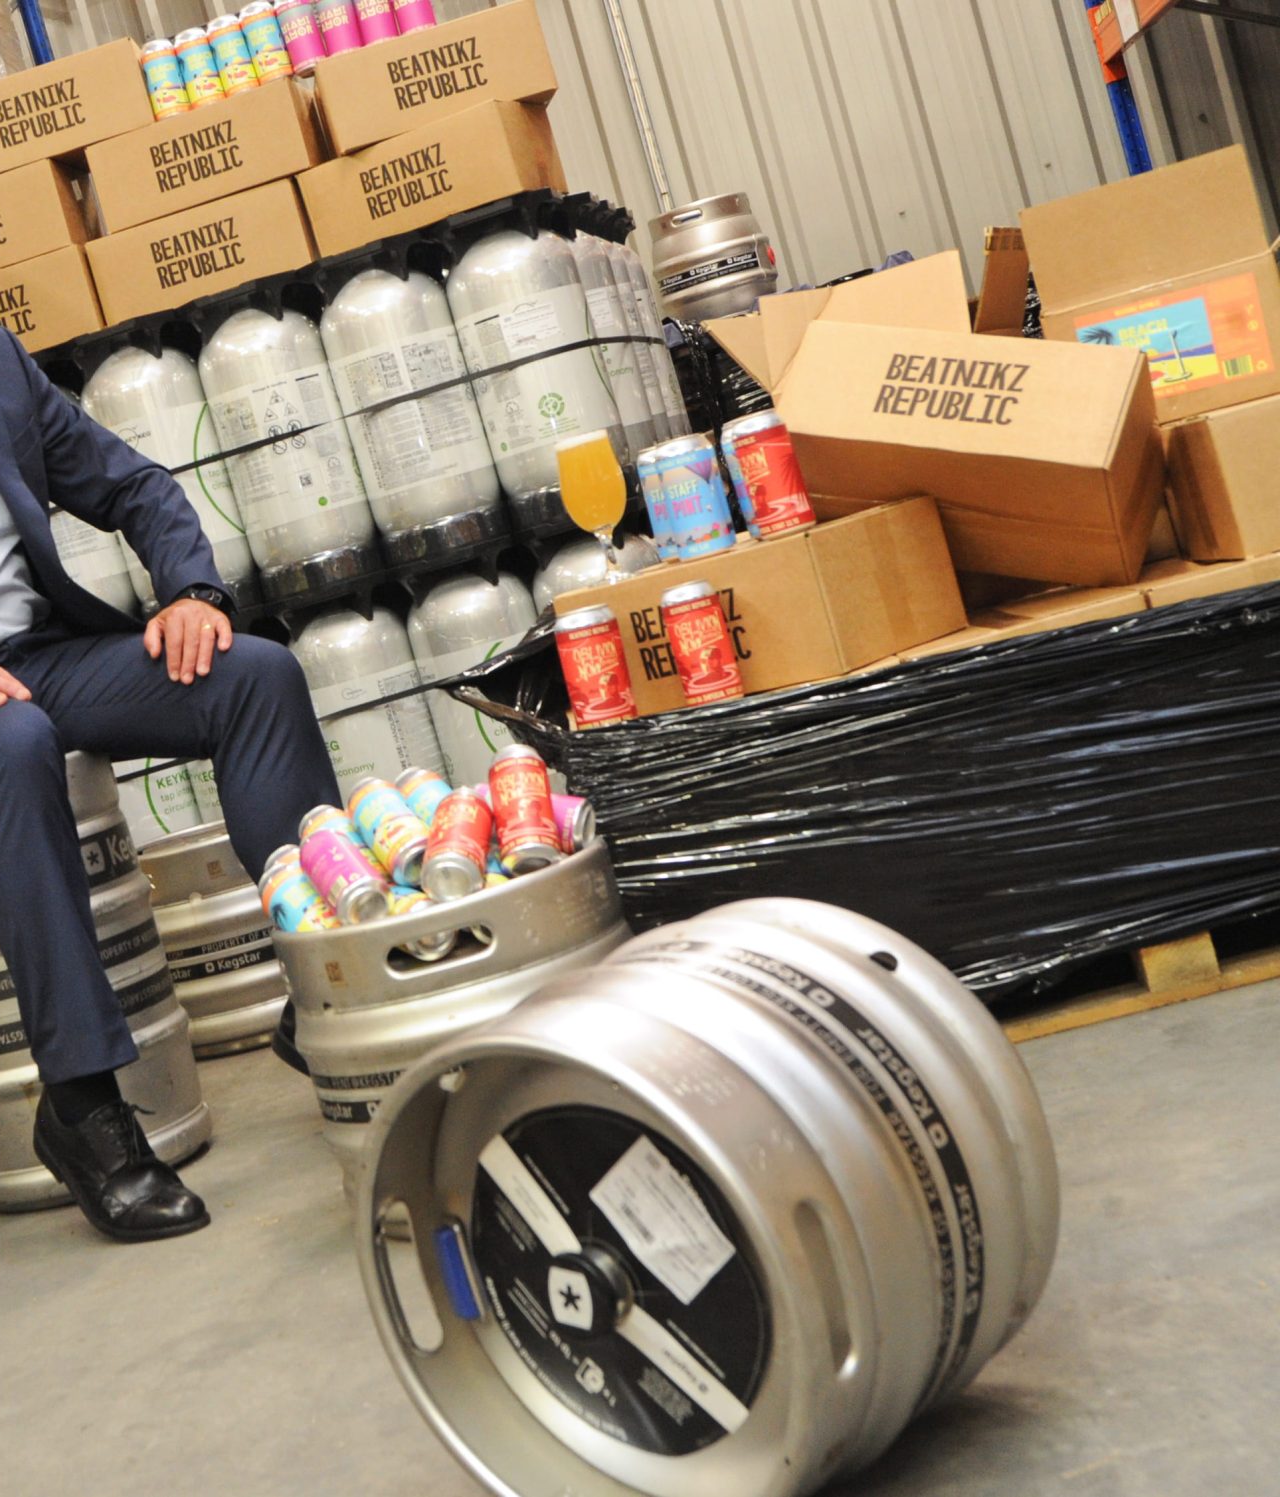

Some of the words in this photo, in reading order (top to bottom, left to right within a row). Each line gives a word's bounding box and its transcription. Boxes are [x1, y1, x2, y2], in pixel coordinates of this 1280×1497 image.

[387, 37, 481, 84] BEATNIKZ
[394, 63, 488, 110] REPUBLIC
[150, 119, 237, 168] BEATNIKZ
[156, 145, 243, 193] REPUBLIC
[359, 142, 446, 194] BEATNIKZ
[366, 169, 453, 220] REPUBLIC
[150, 217, 239, 264] BEATNIKZ
[156, 242, 245, 289] REPUBLIC
[885, 353, 1031, 392] BEATNIKZ
[873, 384, 1019, 426] REPUBLIC
[668, 479, 698, 499] STAFF
[672, 495, 703, 520] PINT
[336, 761, 376, 777] conomy
[202, 937, 248, 954] PROPERTY
[248, 931, 264, 943] OF
[217, 951, 261, 971] Kegstar
[796, 1007, 854, 1065] EMPTY
[853, 1027, 934, 1121] Kegstar
